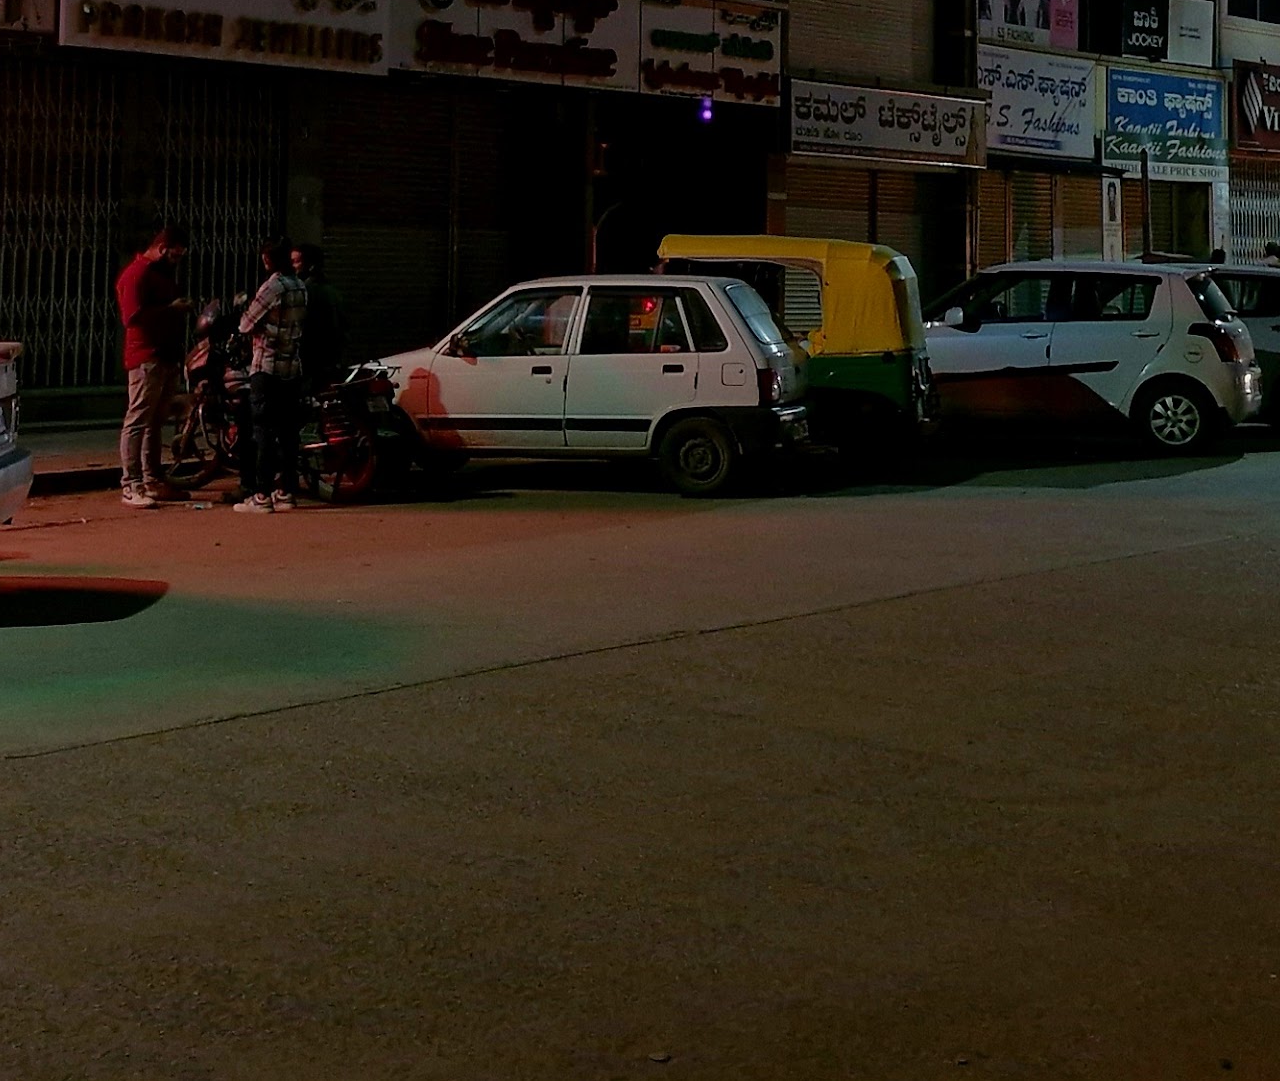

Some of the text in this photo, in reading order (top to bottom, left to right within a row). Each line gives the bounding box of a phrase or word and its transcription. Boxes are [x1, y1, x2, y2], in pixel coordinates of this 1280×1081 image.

[1133, 7, 1159, 28] ಜಾಕಿ
[1127, 32, 1164, 48] JOCKEY
[1117, 87, 1157, 107] ಕಾಂತಿ
[795, 92, 866, 124] ಕಮಲ್
[1022, 108, 1080, 134] Fashions
[1165, 139, 1227, 160] Fashions
[1170, 167, 1197, 177] PRICE
